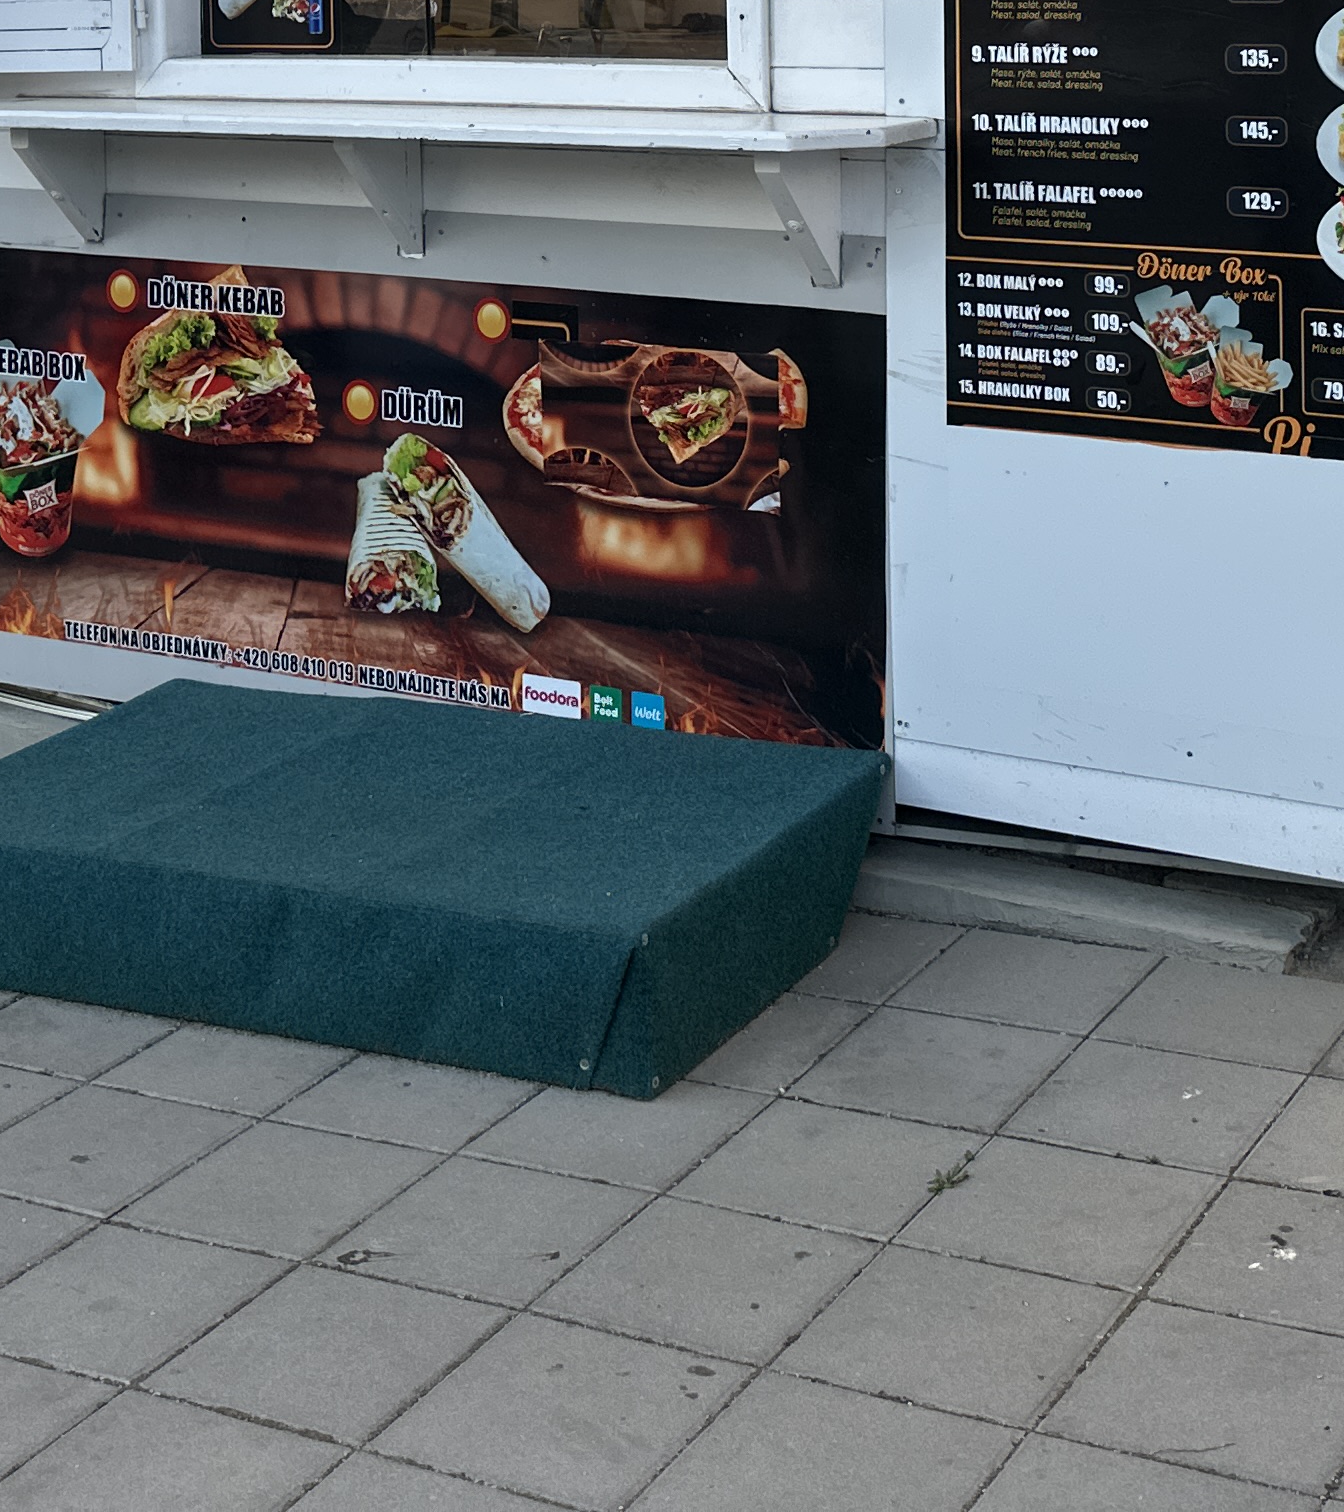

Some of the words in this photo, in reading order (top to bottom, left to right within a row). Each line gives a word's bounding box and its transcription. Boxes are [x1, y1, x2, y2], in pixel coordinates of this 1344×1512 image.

[971, 45, 986, 63] 9.
[987, 42, 1030, 63] TALÍŘ
[1032, 42, 1068, 64] RÝŽE
[1240, 49, 1279, 69] 135,-
[972, 114, 993, 131] 10.
[995, 112, 1036, 133] TALÍŘ
[1040, 115, 1120, 135] HRANOLKY
[1240, 121, 1279, 141] 145,-
[973, 181, 991, 200] 11.
[993, 181, 1035, 202] TALÍŘ
[1038, 185, 1097, 204] FALAFEL
[1242, 192, 1281, 212] 129,-
[1137, 252, 1212, 282] Döner
[1219, 256, 1269, 286] Box
[957, 272, 974, 288] 12.
[976, 273, 1001, 290] BOX
[1005, 274, 1037, 291] MALÝ
[1094, 275, 1124, 295] 99,-
[147, 275, 215, 313] DÖNER
[217, 284, 285, 317] KEBAB
[957, 302, 975, 317] 13.
[977, 303, 1002, 319] BOX
[1004, 304, 1041, 321] VELKÝ
[1091, 313, 1129, 334] 109,-
[1310, 321, 1331, 338] 16.
[958, 343, 976, 358] 14.
[977, 344, 1003, 360] BOX
[1004, 345, 1052, 364] FALAFEL
[1095, 353, 1125, 374] 89,-
[48, 351, 86, 383] BOX
[958, 379, 977, 395] 15.
[978, 380, 1043, 400] HRANOLKY
[1044, 386, 1071, 402] BOX
[1096, 390, 1127, 411] 50,-
[381, 387, 464, 428] DÜRÜM
[30, 494, 55, 510] BOX
[64, 620, 118, 645] TELEFON
[121, 628, 139, 648] NA
[234, 647, 269, 669] +420
[271, 652, 298, 673] 608
[302, 657, 326, 678] 410
[329, 661, 354, 682] 019
[358, 665, 395, 689] NEBO
[397, 668, 456, 700] NÁJDETE
[458, 679, 488, 704] NÁS
[491, 687, 511, 708] NA
[593, 704, 619, 718] Food
[634, 706, 662, 722] Wolt
